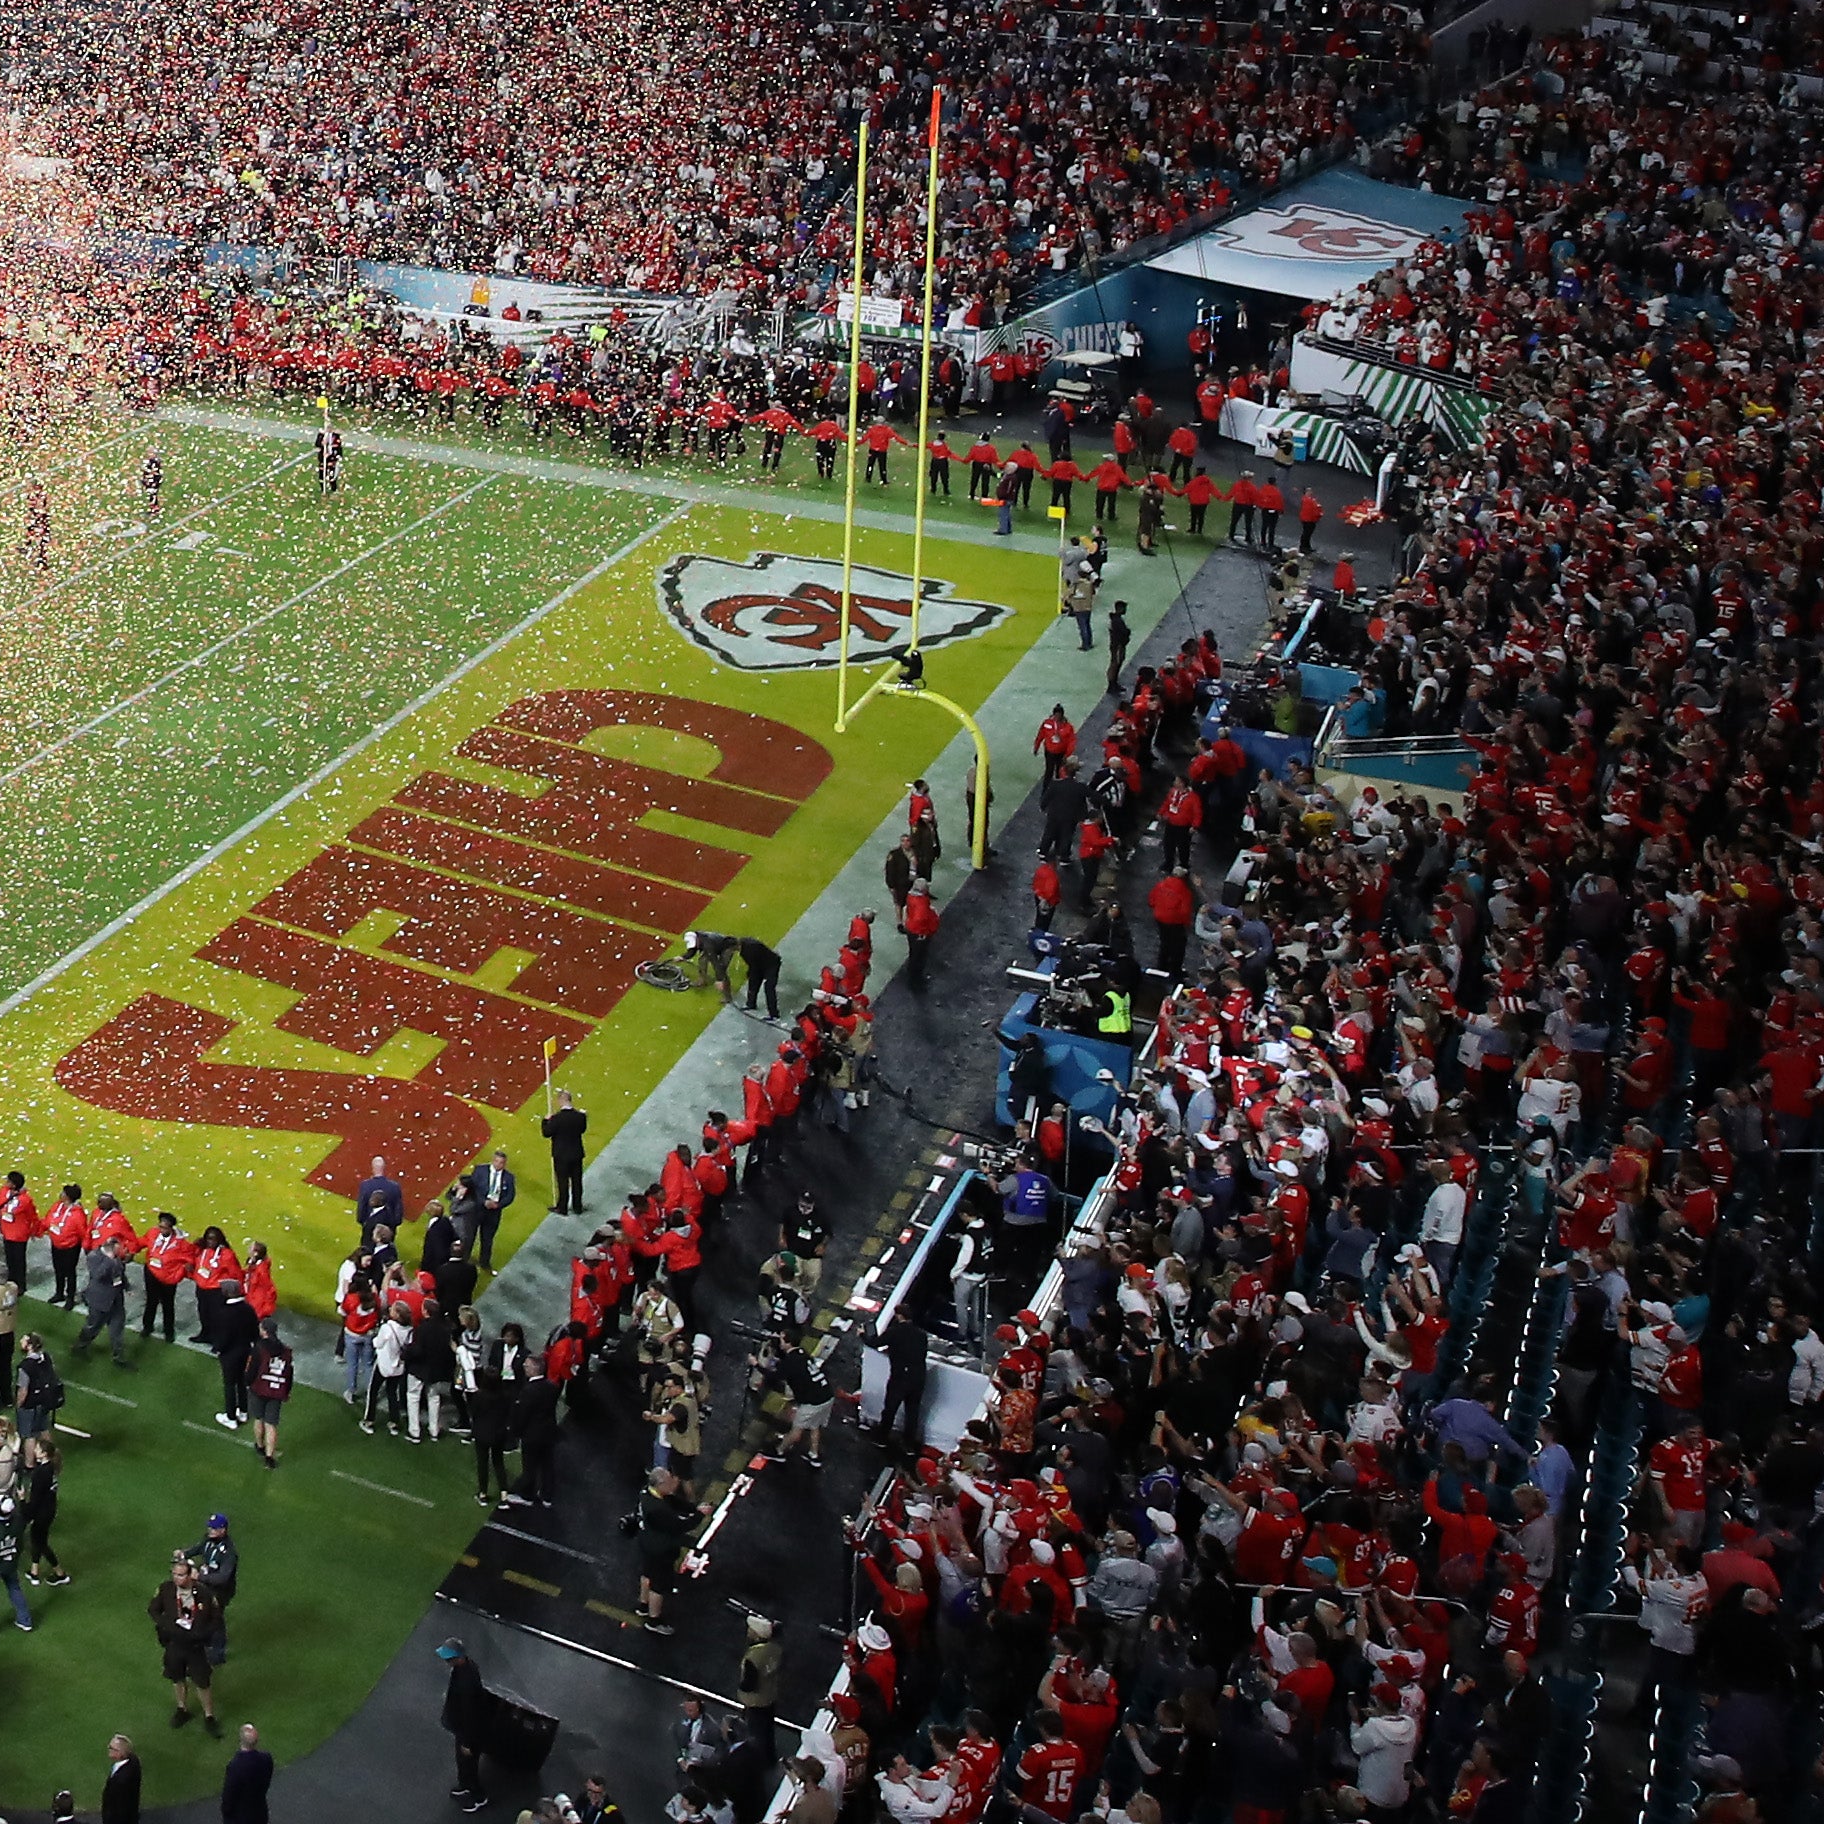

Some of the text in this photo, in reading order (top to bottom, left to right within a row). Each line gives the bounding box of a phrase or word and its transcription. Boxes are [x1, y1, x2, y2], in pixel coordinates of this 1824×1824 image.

[1718, 605, 1736, 620] 15
[54, 688, 834, 1223] CHIEFS
[1555, 1097, 1571, 1114] 15
[1045, 1768, 1076, 1804] 15
